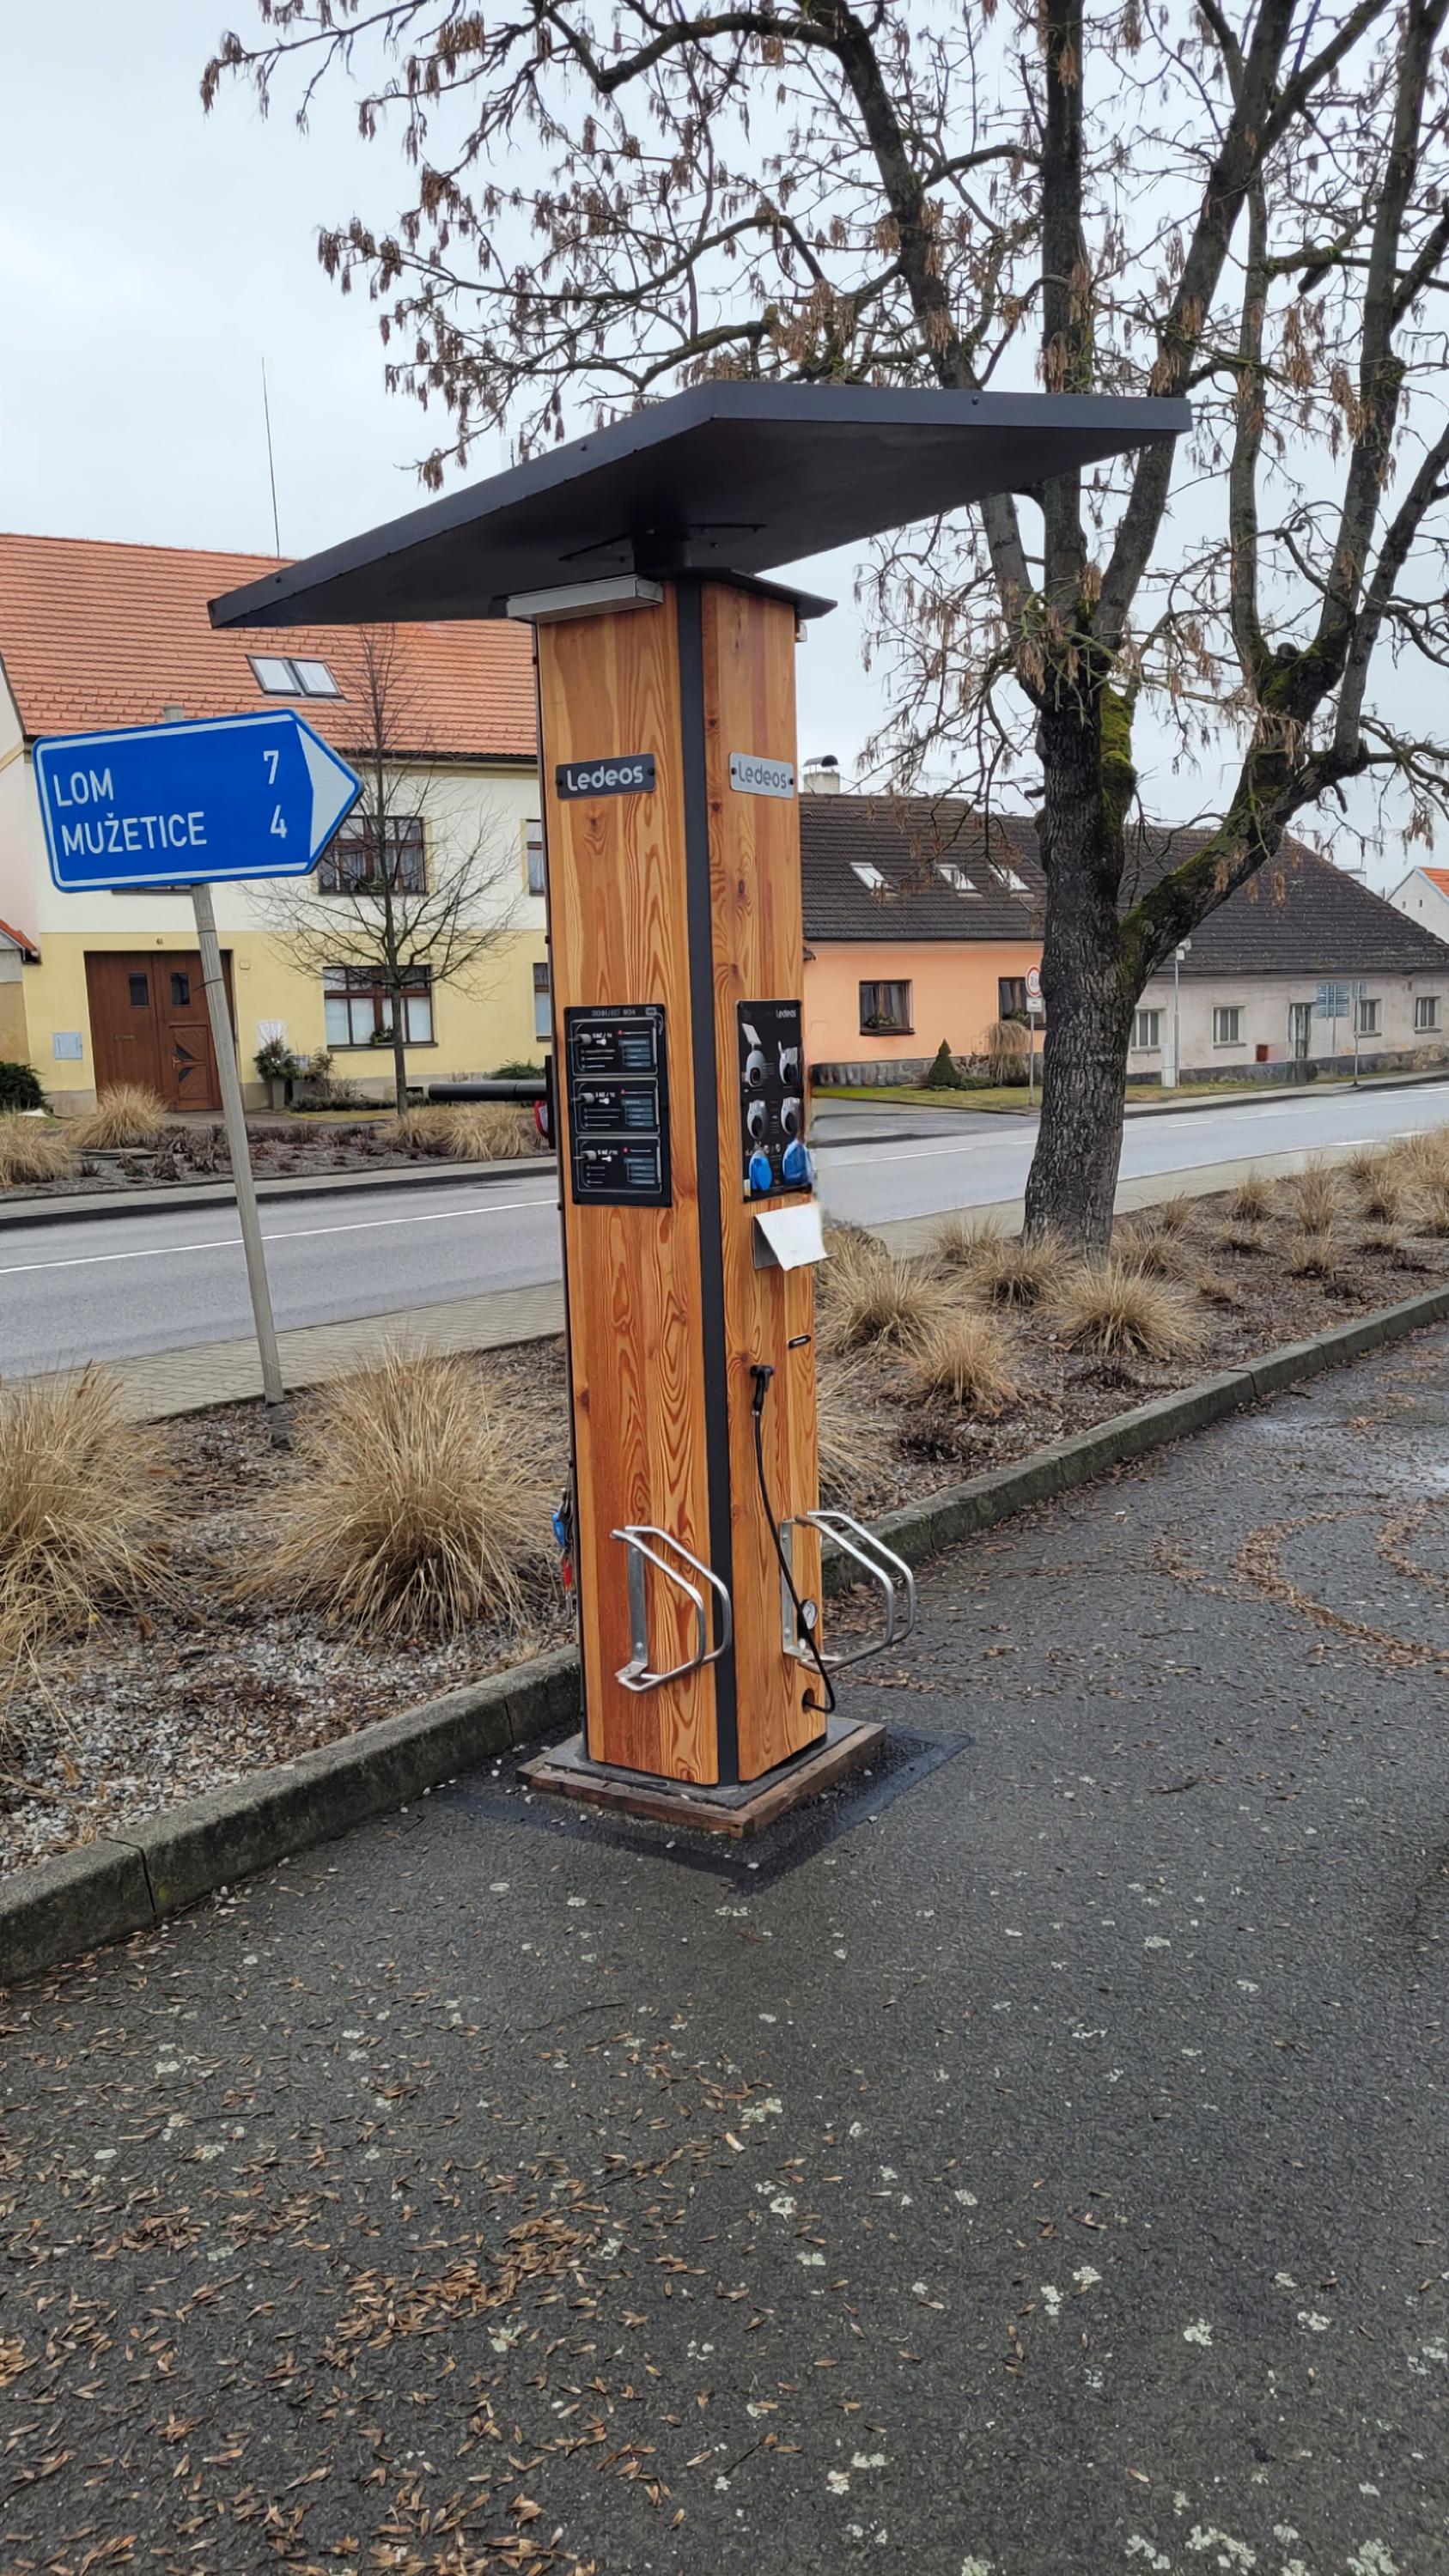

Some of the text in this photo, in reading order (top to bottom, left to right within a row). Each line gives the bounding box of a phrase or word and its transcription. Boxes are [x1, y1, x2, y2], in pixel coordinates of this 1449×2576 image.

[53, 750, 279, 806] LOM 7
[566, 765, 644, 792] Ledeos
[737, 761, 788, 790] Ledeos
[61, 805, 288, 856] MUŽETICE 4
